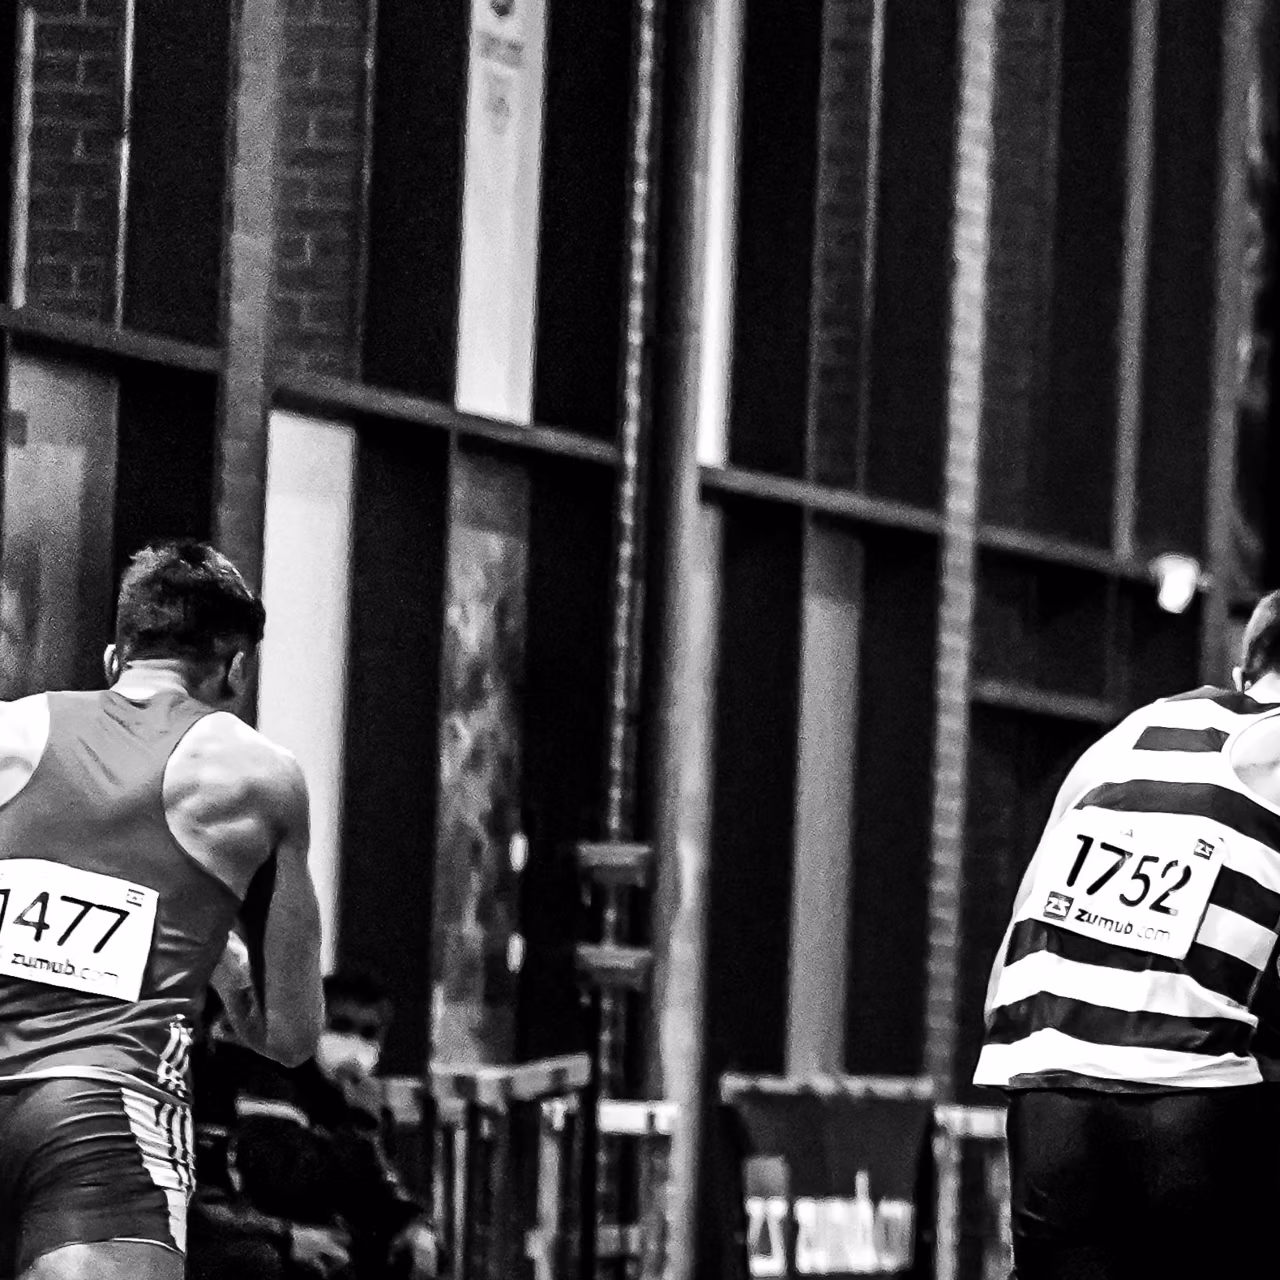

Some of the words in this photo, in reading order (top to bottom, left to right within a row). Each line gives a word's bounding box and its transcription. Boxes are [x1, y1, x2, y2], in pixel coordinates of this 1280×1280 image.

[1067, 834, 1192, 916] 1752
[0, 888, 130, 954] 1477
[1074, 908, 1171, 941] zumubcom
[11, 952, 119, 984] zumub.cm
